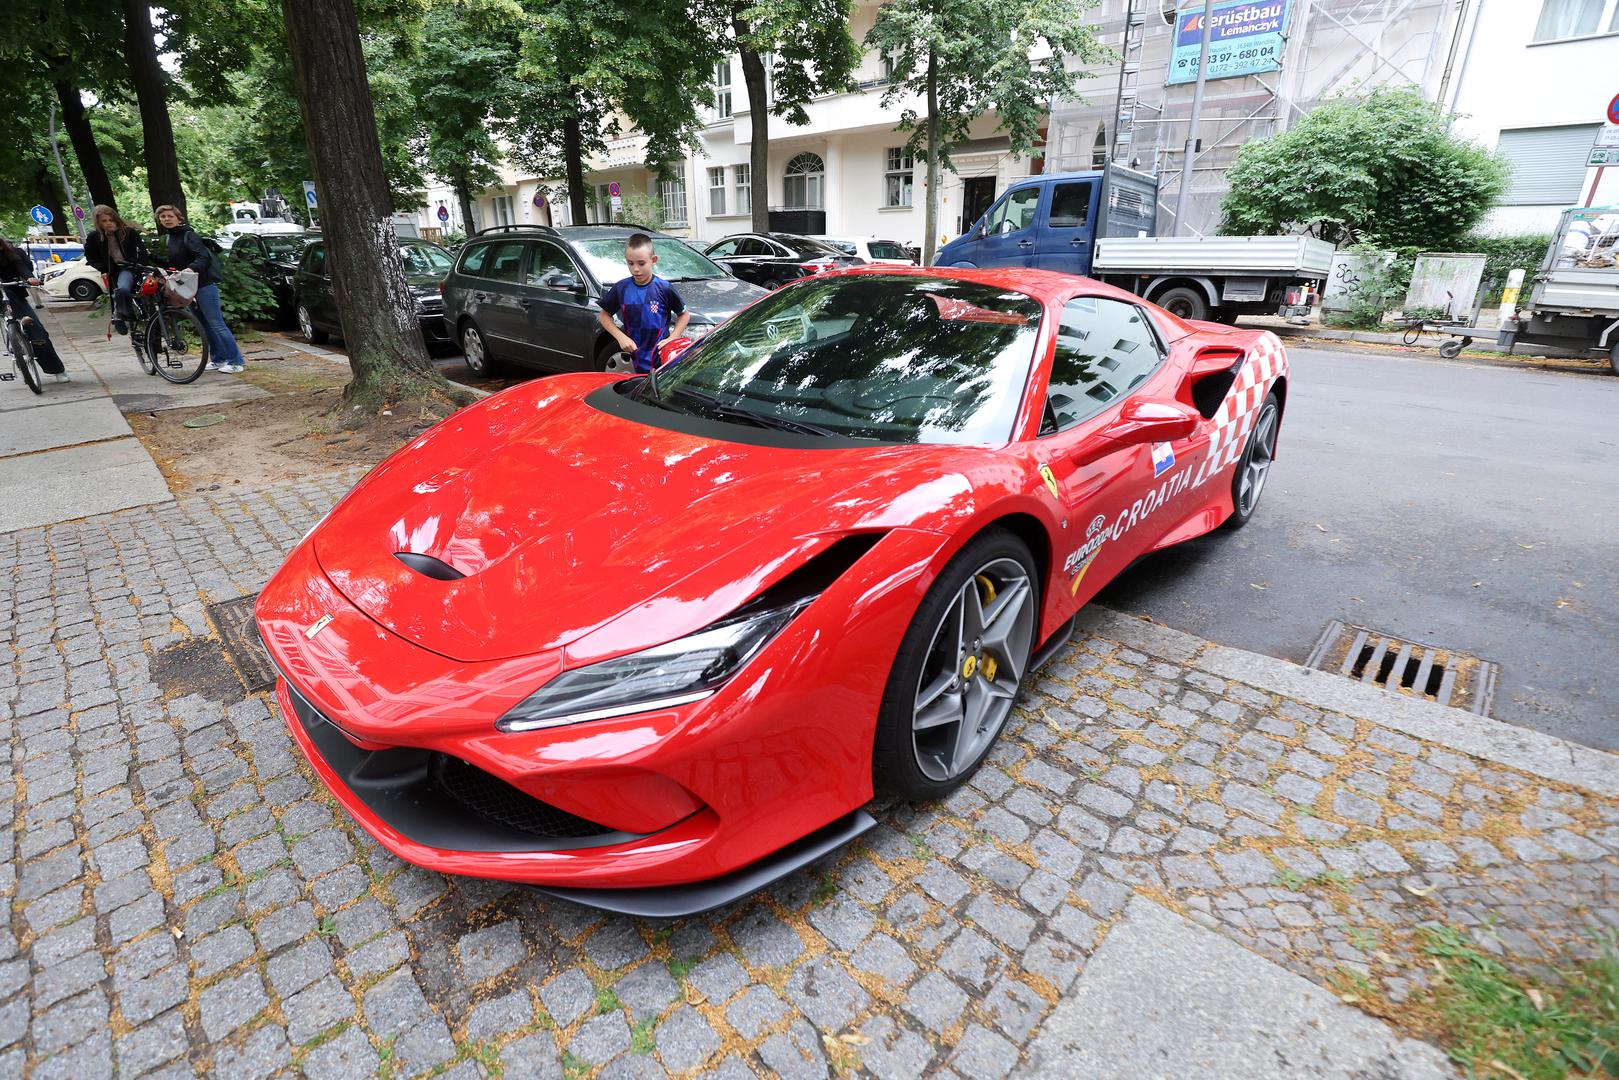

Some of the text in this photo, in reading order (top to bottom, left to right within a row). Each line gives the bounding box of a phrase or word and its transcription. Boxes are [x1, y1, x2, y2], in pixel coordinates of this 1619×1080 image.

[1221, 19, 1279, 37] Lemanczyk
[1219, 53, 1232, 62] 97
[1239, 49, 1258, 60] 680
[1260, 46, 1274, 56] 04
[1112, 465, 1193, 541] CROATIA
